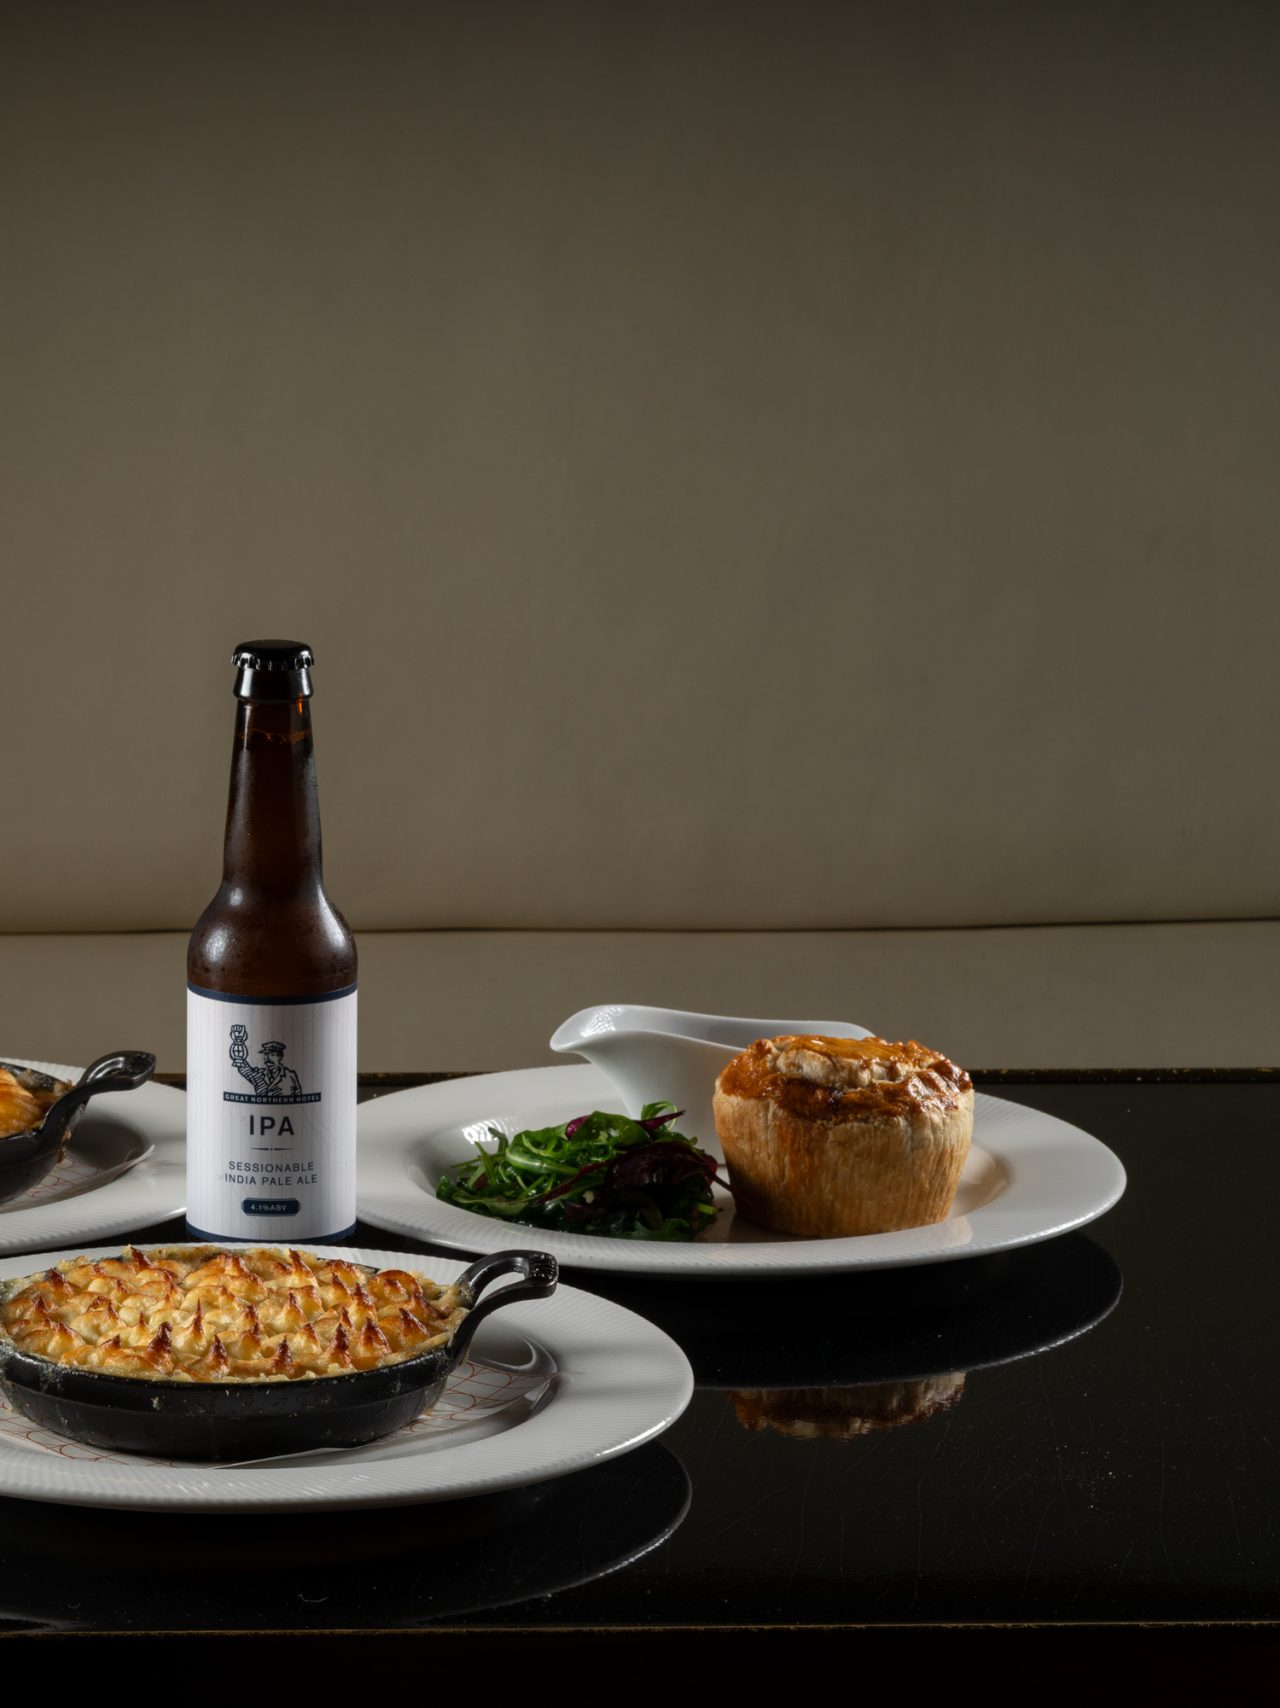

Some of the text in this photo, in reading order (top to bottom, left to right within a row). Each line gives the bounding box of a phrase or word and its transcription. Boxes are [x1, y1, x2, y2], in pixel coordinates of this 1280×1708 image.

[225, 1093, 249, 1102] GREAT
[296, 1094, 320, 1102] HOTEL
[249, 1114, 295, 1137] IPA
[228, 1160, 315, 1173] SESSIONABLE
[224, 1173, 318, 1186] INDIA PALE ALE
